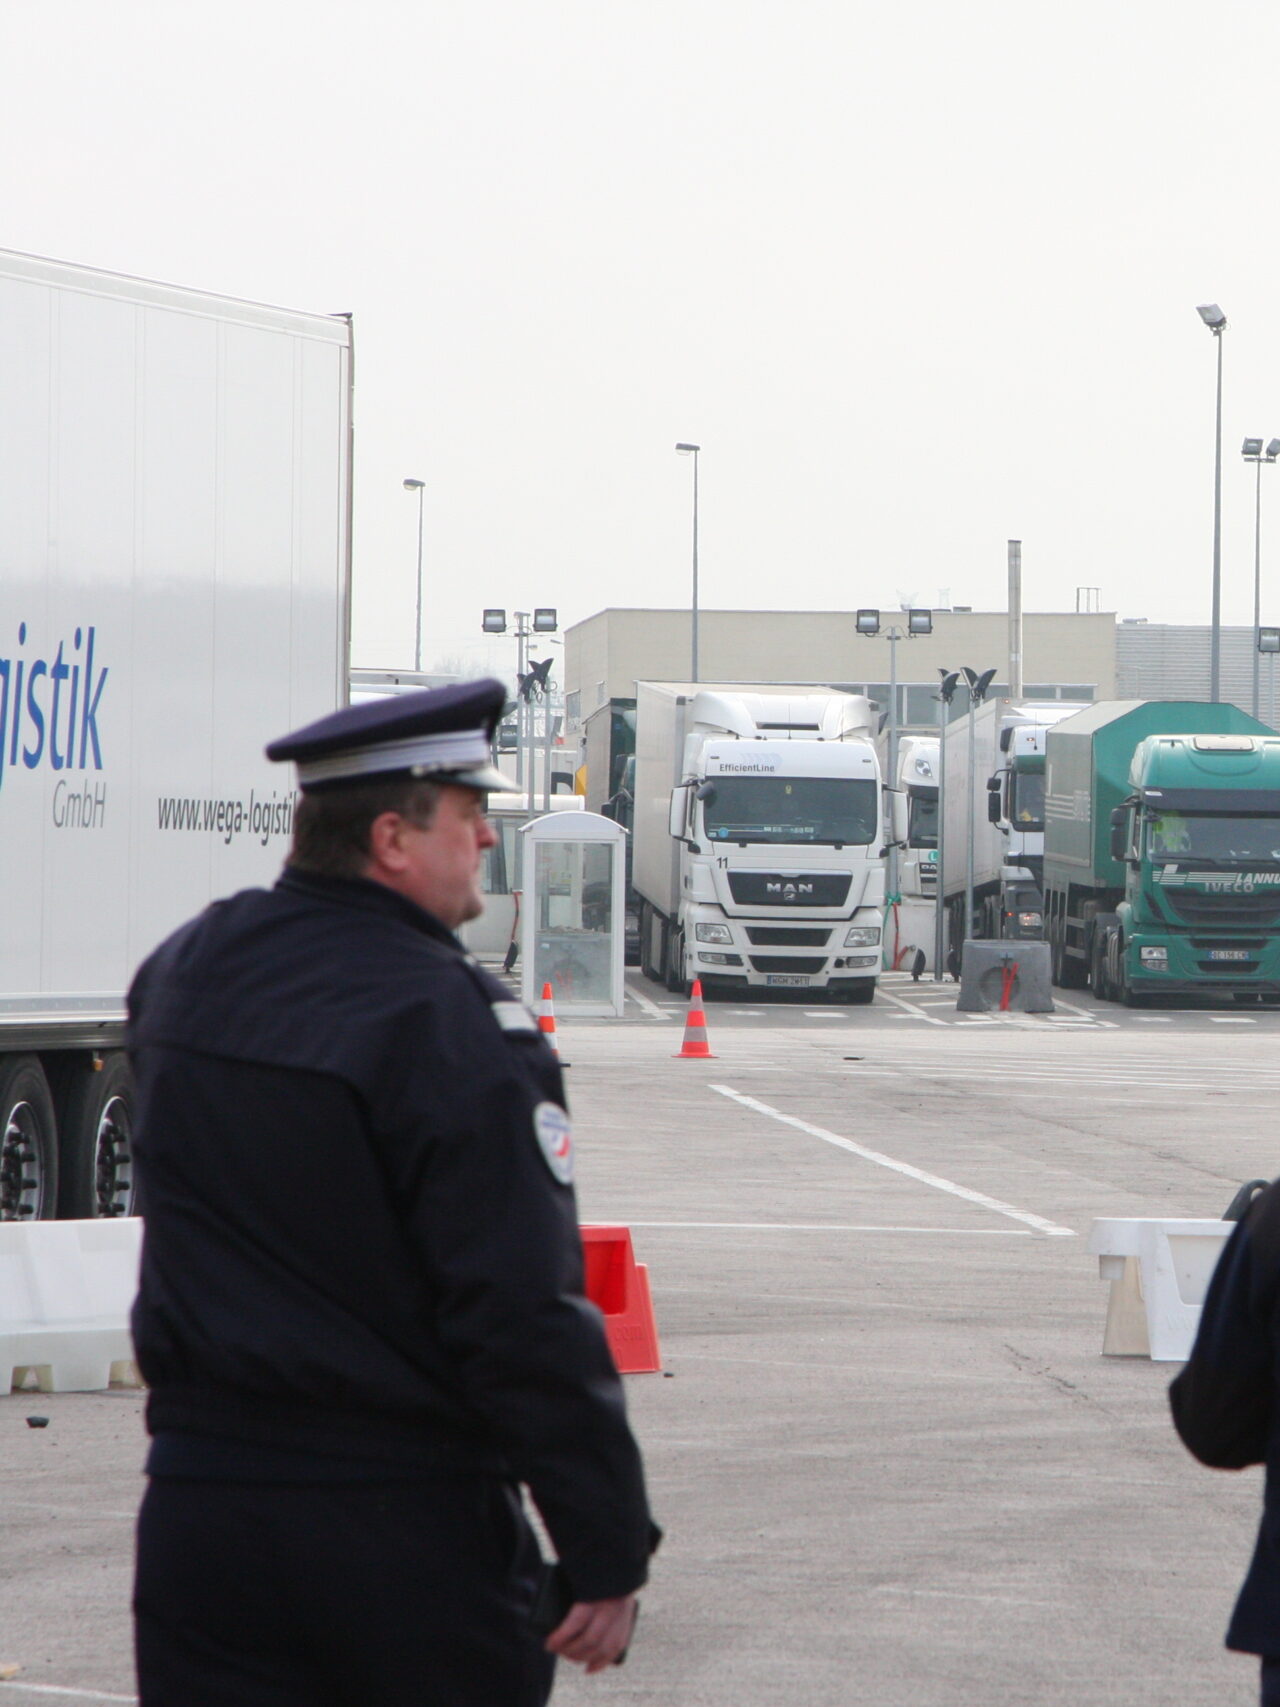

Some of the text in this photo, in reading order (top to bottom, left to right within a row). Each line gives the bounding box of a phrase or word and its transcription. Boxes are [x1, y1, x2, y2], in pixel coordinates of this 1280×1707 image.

[720, 764, 775, 772] EfficientLine
[53, 779, 106, 828] GmbH
[717, 857, 728, 869] 11
[766, 883, 813, 893] MAN
[1204, 882, 1255, 893] IVECO
